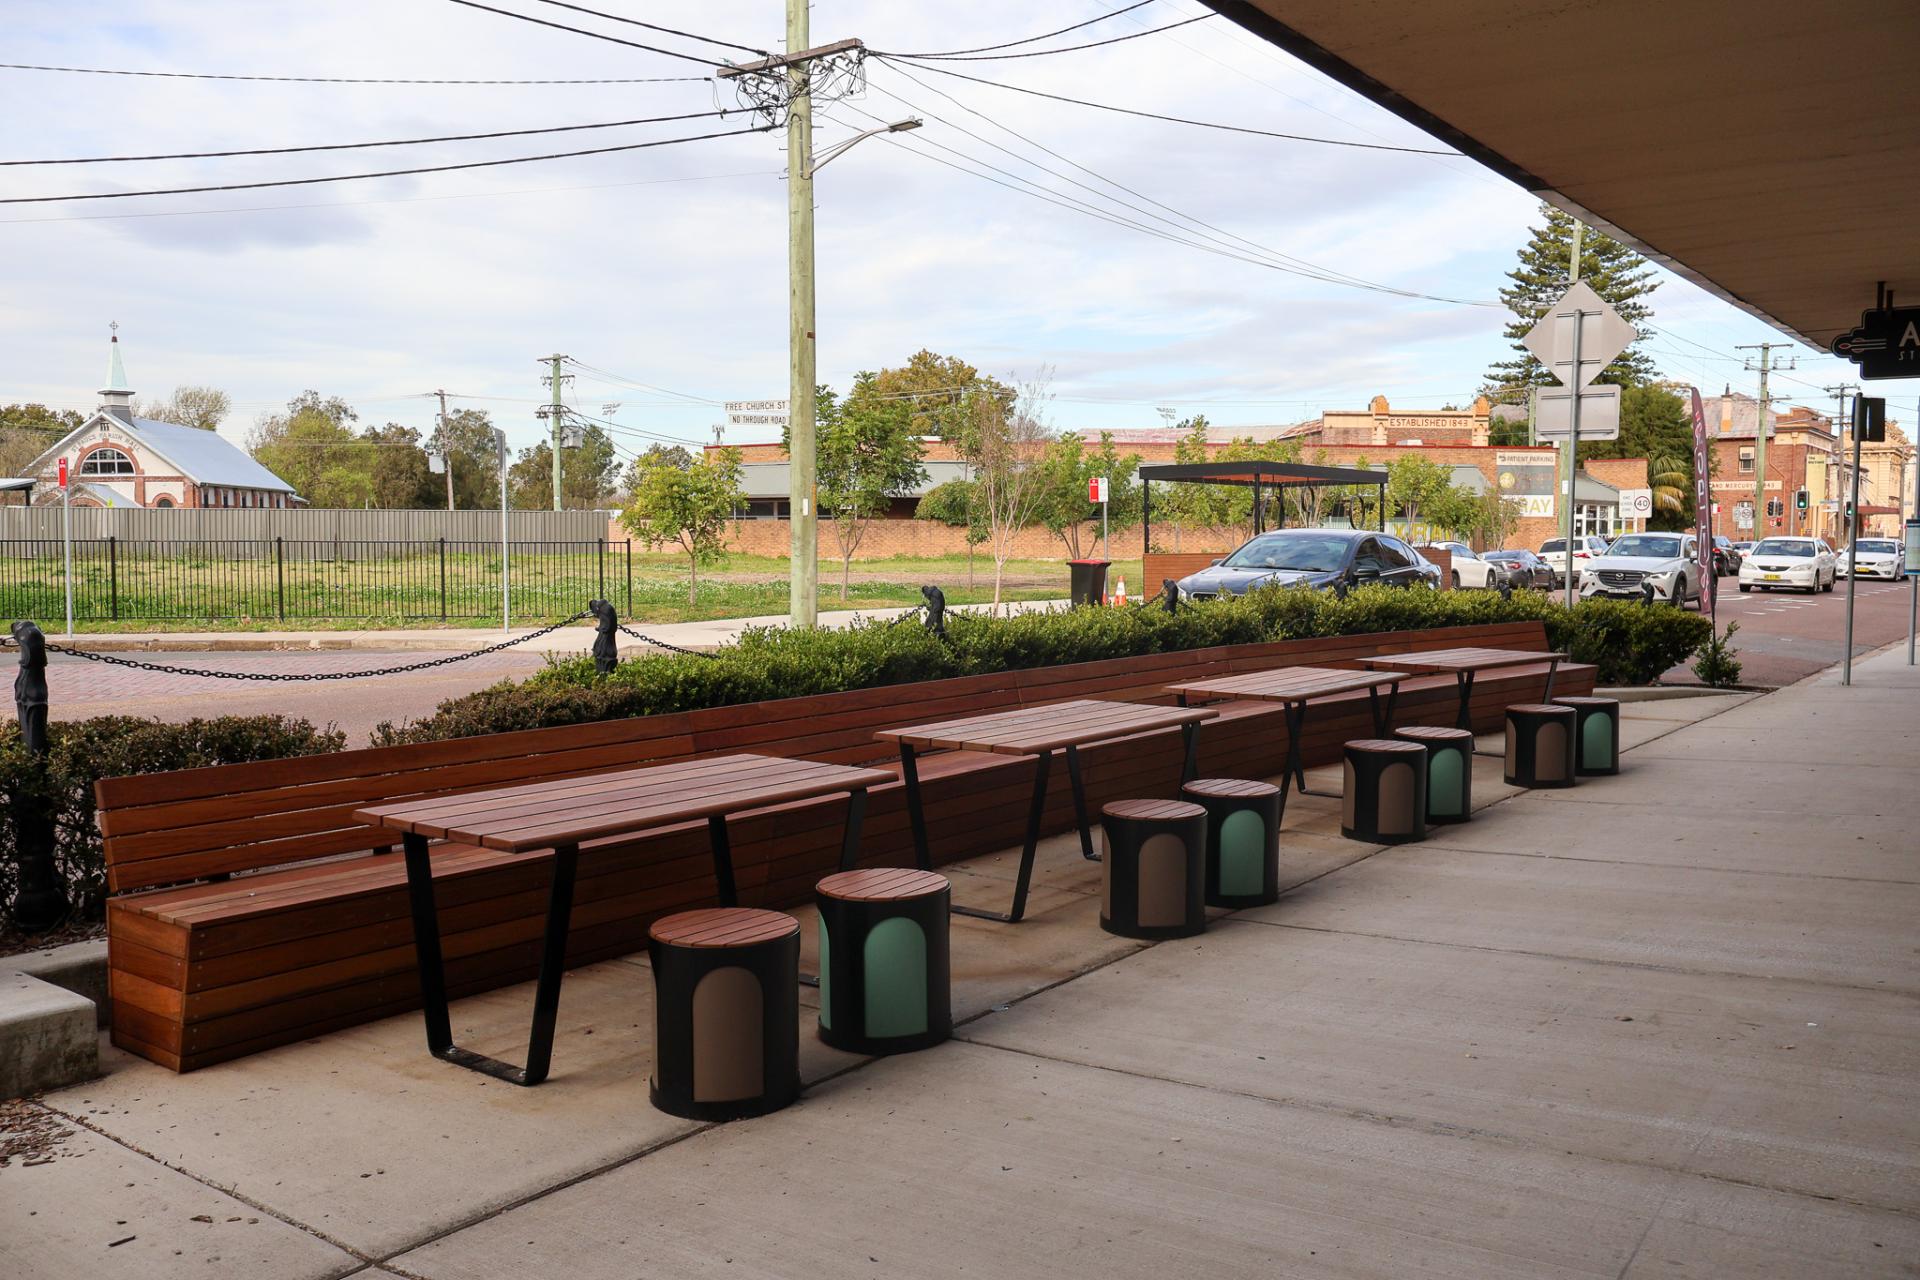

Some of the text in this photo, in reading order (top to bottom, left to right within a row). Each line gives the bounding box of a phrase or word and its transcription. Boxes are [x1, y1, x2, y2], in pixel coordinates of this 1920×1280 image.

[725, 401, 786, 411] FREE CHURCH ST
[732, 416, 787, 424] NO THROUGH ROAD
[1390, 419, 1468, 427] ESTABLISHED 1843
